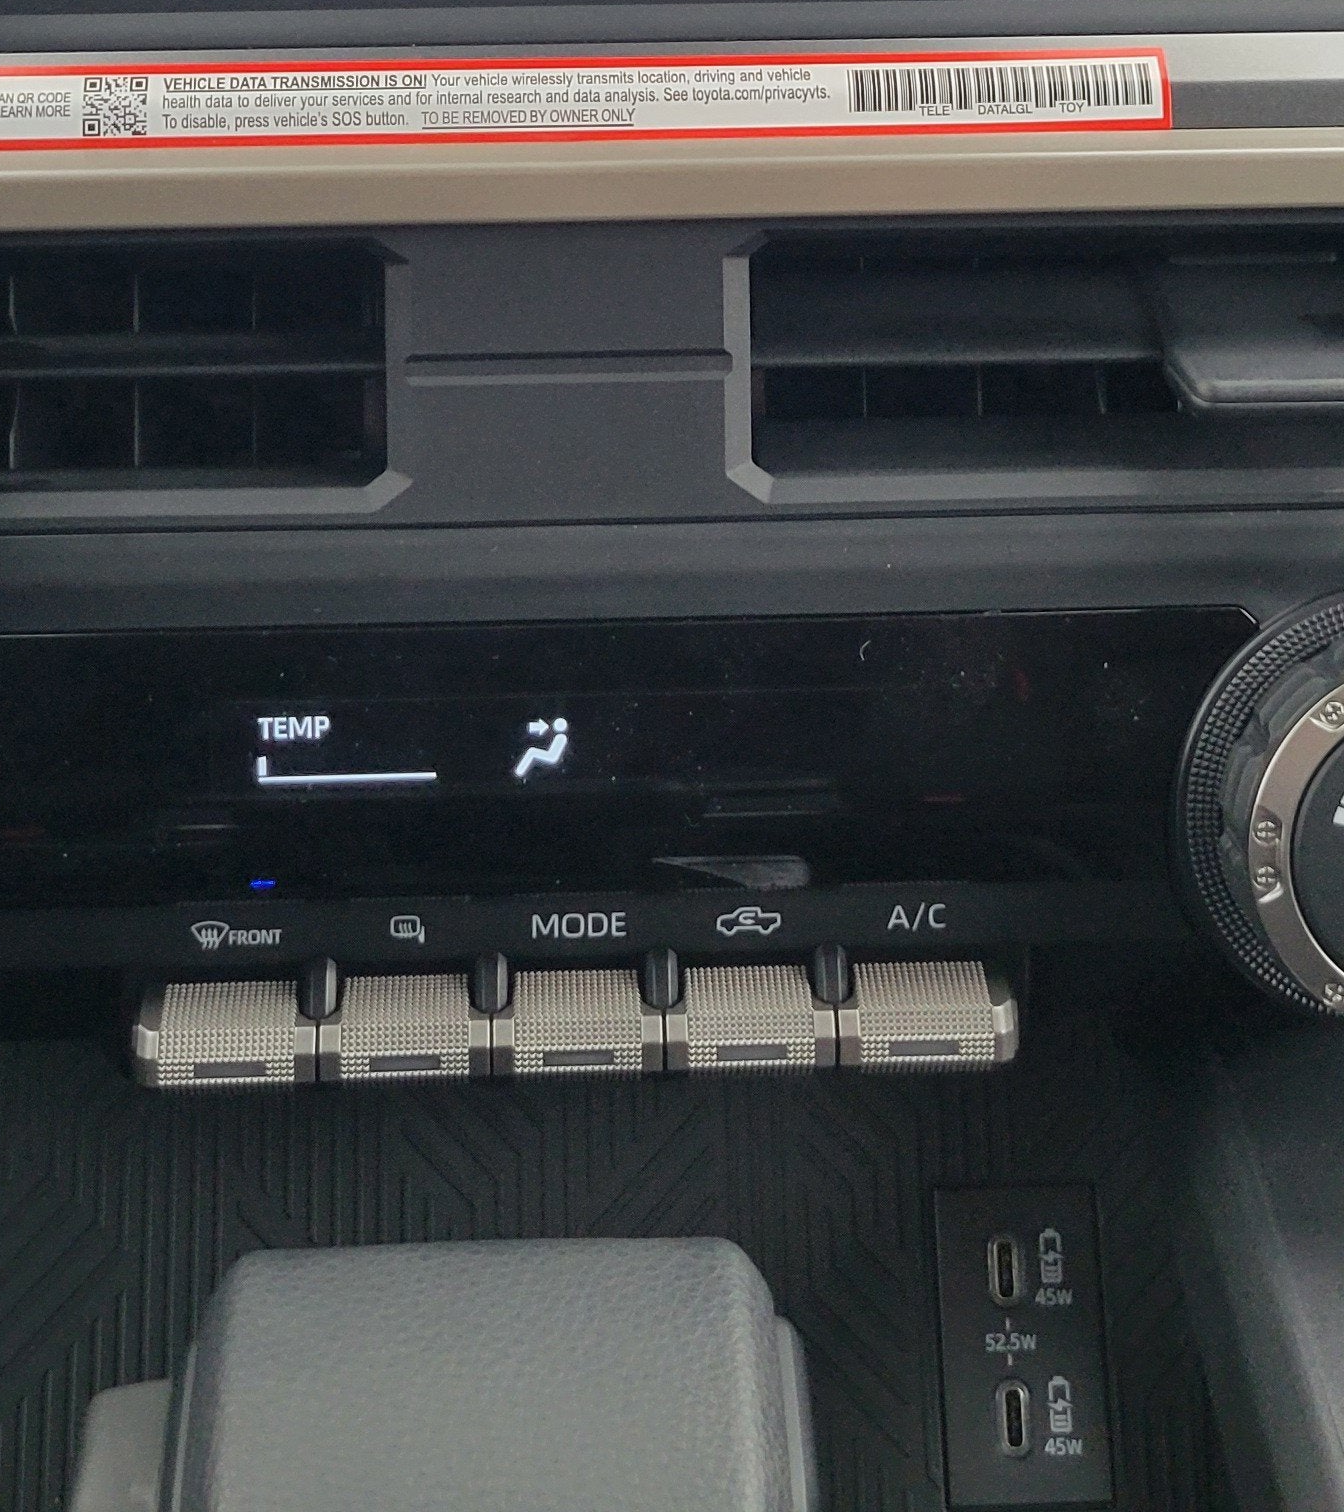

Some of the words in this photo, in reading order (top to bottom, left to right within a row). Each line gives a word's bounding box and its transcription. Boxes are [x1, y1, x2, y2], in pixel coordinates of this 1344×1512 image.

[164, 77, 225, 90] VEHICLE
[230, 76, 267, 89] DATA
[271, 75, 380, 88] TRANSMISSION
[384, 74, 397, 87] IS
[402, 73, 427, 88] ON!
[431, 73, 461, 86] Your
[464, 73, 507, 86] vehicle
[512, 72, 573, 89] wirelessly
[577, 72, 634, 84] transmits
[638, 70, 690, 85] location,
[694, 69, 735, 86] driving
[740, 69, 763, 82] and
[767, 68, 811, 82] vehicle
[17, 92, 34, 105] QR
[38, 92, 71, 104] CODE
[162, 95, 201, 109] health
[206, 95, 233, 109] data
[237, 95, 250, 108] to
[255, 93, 297, 107] deliver
[300, 95, 328, 111] your
[332, 92, 384, 106] services
[388, 92, 411, 105] and
[416, 91, 432, 105] for
[437, 90, 483, 105] internal
[487, 90, 541, 104] research
[546, 89, 569, 103] and
[574, 89, 600, 103] data
[605, 88, 659, 106] analysis.
[664, 87, 688, 101] See
[692, 85, 831, 105] toyota.com/privacyvts.
[36, 105, 71, 117] MORE
[919, 105, 950, 116] TELE
[978, 103, 1033, 115] DATALGL
[1060, 102, 1085, 113] TOY
[162, 114, 177, 129] To
[181, 113, 230, 130] disable,
[235, 115, 269, 131] press
[274, 112, 328, 127] vehicle's
[332, 111, 362, 126] SOS
[366, 111, 409, 126] button.
[421, 111, 439, 125] TO
[442, 110, 459, 124] BE
[463, 110, 527, 124] REMOVED
[530, 109, 548, 123] BY
[550, 108, 599, 123] OWNER
[601, 108, 636, 122] ONLY
[257, 715, 331, 740] TEMP
[532, 911, 627, 939] MODE
[888, 903, 947, 931] A/C
[228, 928, 281, 946] FRONT
[1035, 1288, 1073, 1306] 45W
[1044, 1438, 1084, 1456] 45W
